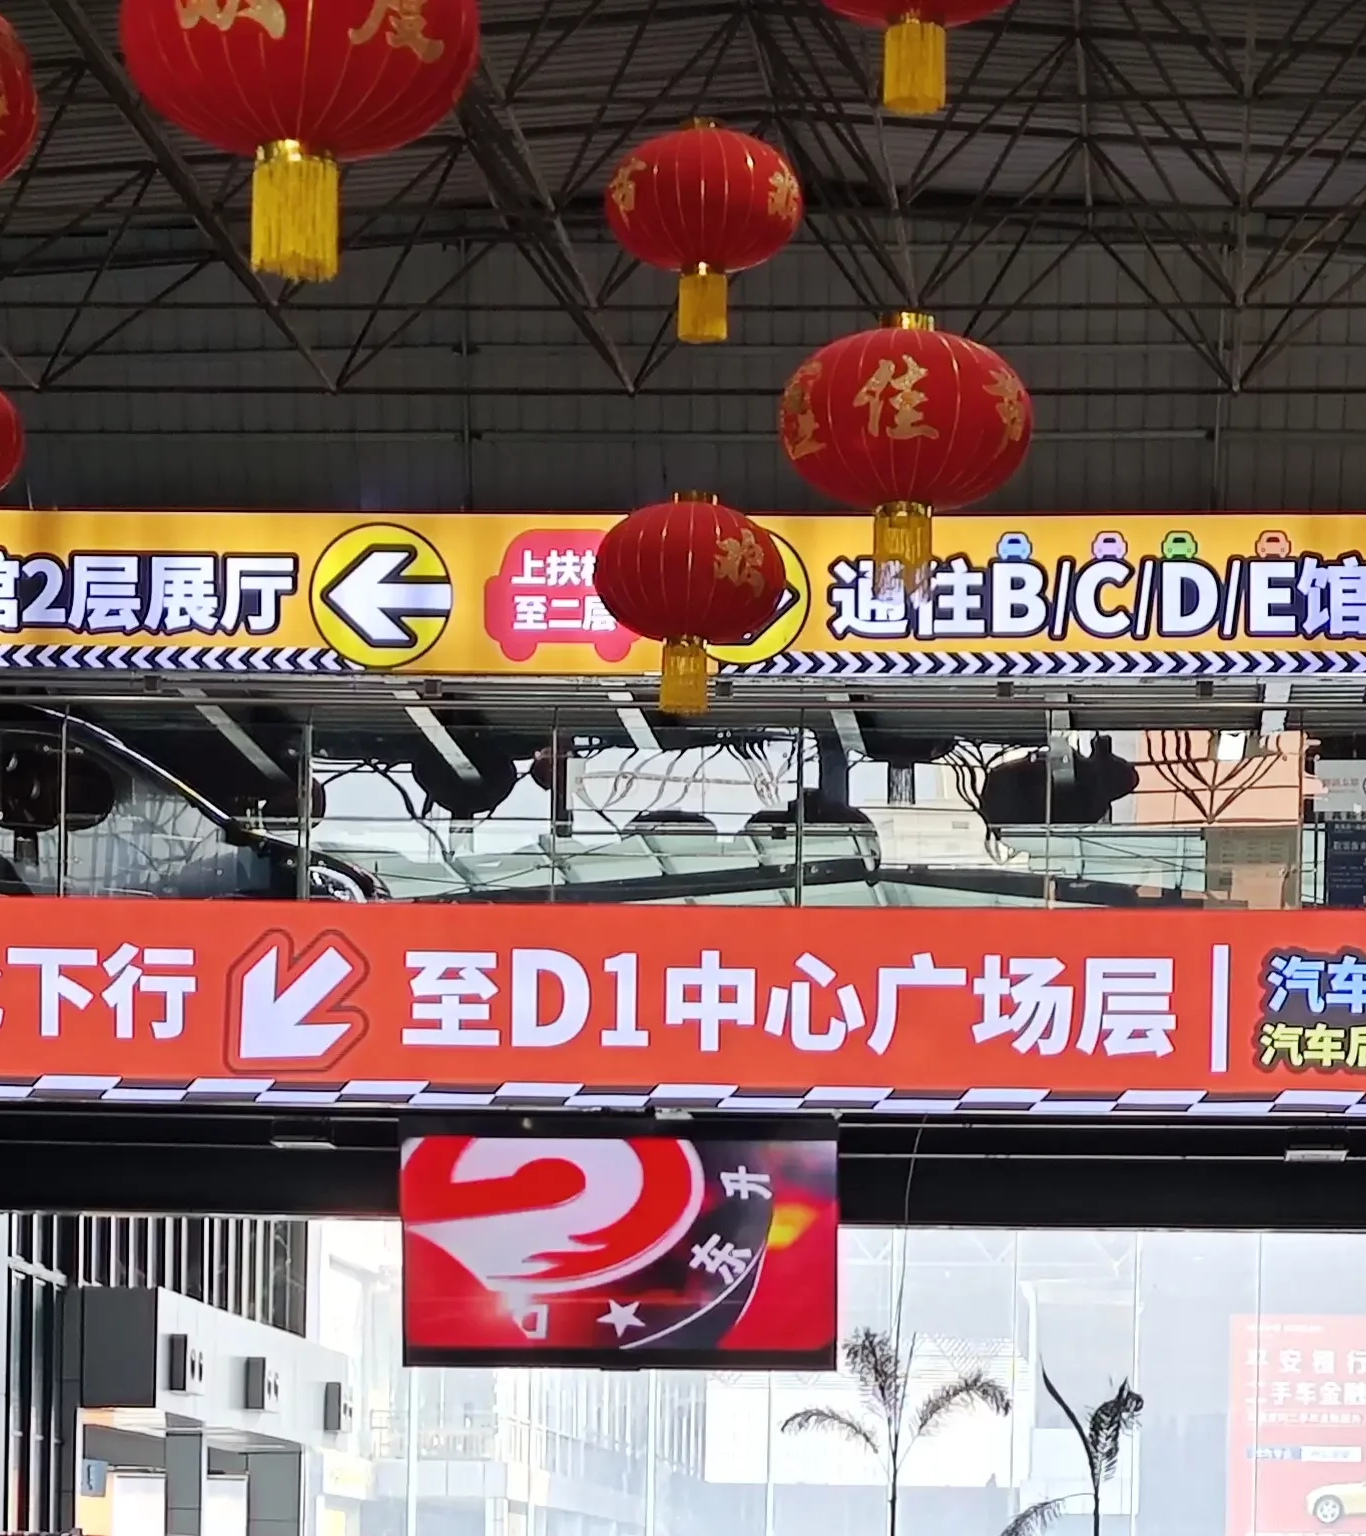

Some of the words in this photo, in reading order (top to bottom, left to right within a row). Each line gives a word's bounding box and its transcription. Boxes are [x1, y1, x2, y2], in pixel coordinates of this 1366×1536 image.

[851, 355, 939, 440] 佳
[401, 946, 1179, 1058] 至D1中心广场层
